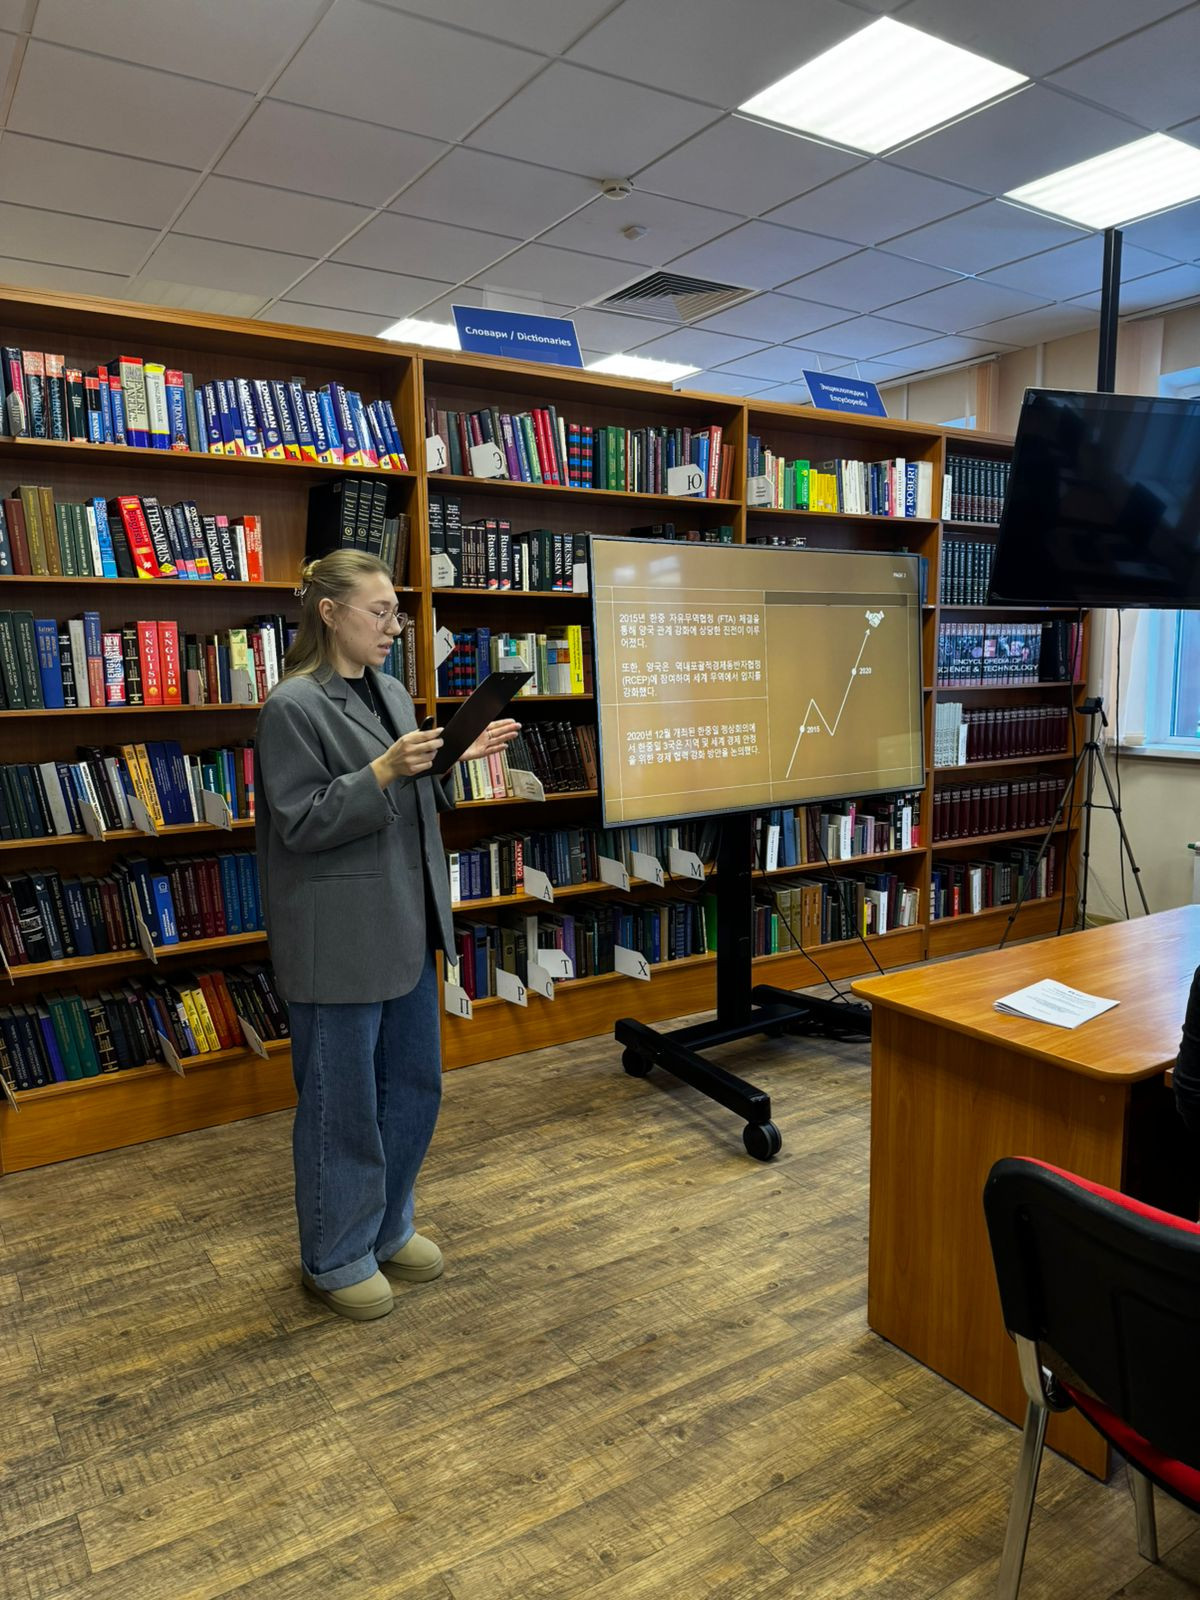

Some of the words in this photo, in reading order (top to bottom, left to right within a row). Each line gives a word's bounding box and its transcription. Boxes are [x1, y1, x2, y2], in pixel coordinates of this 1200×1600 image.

[465, 326, 508, 339] Словари
[517, 332, 572, 347] Dictionaries
[30, 376, 45, 437] CAMBRIDGE
[172, 390, 184, 432] DICTIONARY
[219, 382, 229, 414] LONGMAN
[261, 381, 277, 428] LONGMAN
[277, 384, 292, 432] LONGMAN
[293, 383, 308, 433] LONGMAN
[340, 386, 353, 431] LONGMAN
[310, 391, 325, 440] LONGMAN
[493, 452, 502, 469] Э
[688, 473, 702, 490] Ю
[905, 467, 915, 506] ROBERT
[128, 510, 142, 544] English
[136, 509, 149, 542] MACMILLAN
[147, 507, 171, 563] THESAURUS
[190, 507, 202, 538] OXFORD
[207, 523, 225, 573] THESAURUS
[221, 531, 235, 569] POLITICS
[487, 534, 497, 572] Russian
[500, 535, 509, 573] Russian
[554, 542, 562, 575] RUSSIAN
[564, 543, 572, 575] RUSSIAN
[619, 614, 645, 623] 2015년
[717, 614, 736, 625] (FTA)
[105, 646, 115, 678] ENGLISH
[113, 646, 122, 678] RUSSIAN
[145, 630, 158, 686] ENGLISH
[164, 631, 177, 686] ENGLISH
[859, 667, 872, 675] 2020
[953, 658, 1010, 666] ENCYCLOPEDIA
[982, 664, 1039, 672] TECHNOLOGY
[626, 731, 653, 741] 2020년
[655, 729, 671, 740] 12월
[806, 726, 820, 734] 2015
[691, 862, 702, 877] М
[543, 885, 551, 900] А
[561, 960, 569, 974] Т
[517, 986, 525, 1001] Р
[545, 981, 552, 997] С
[460, 998, 470, 1015] П
